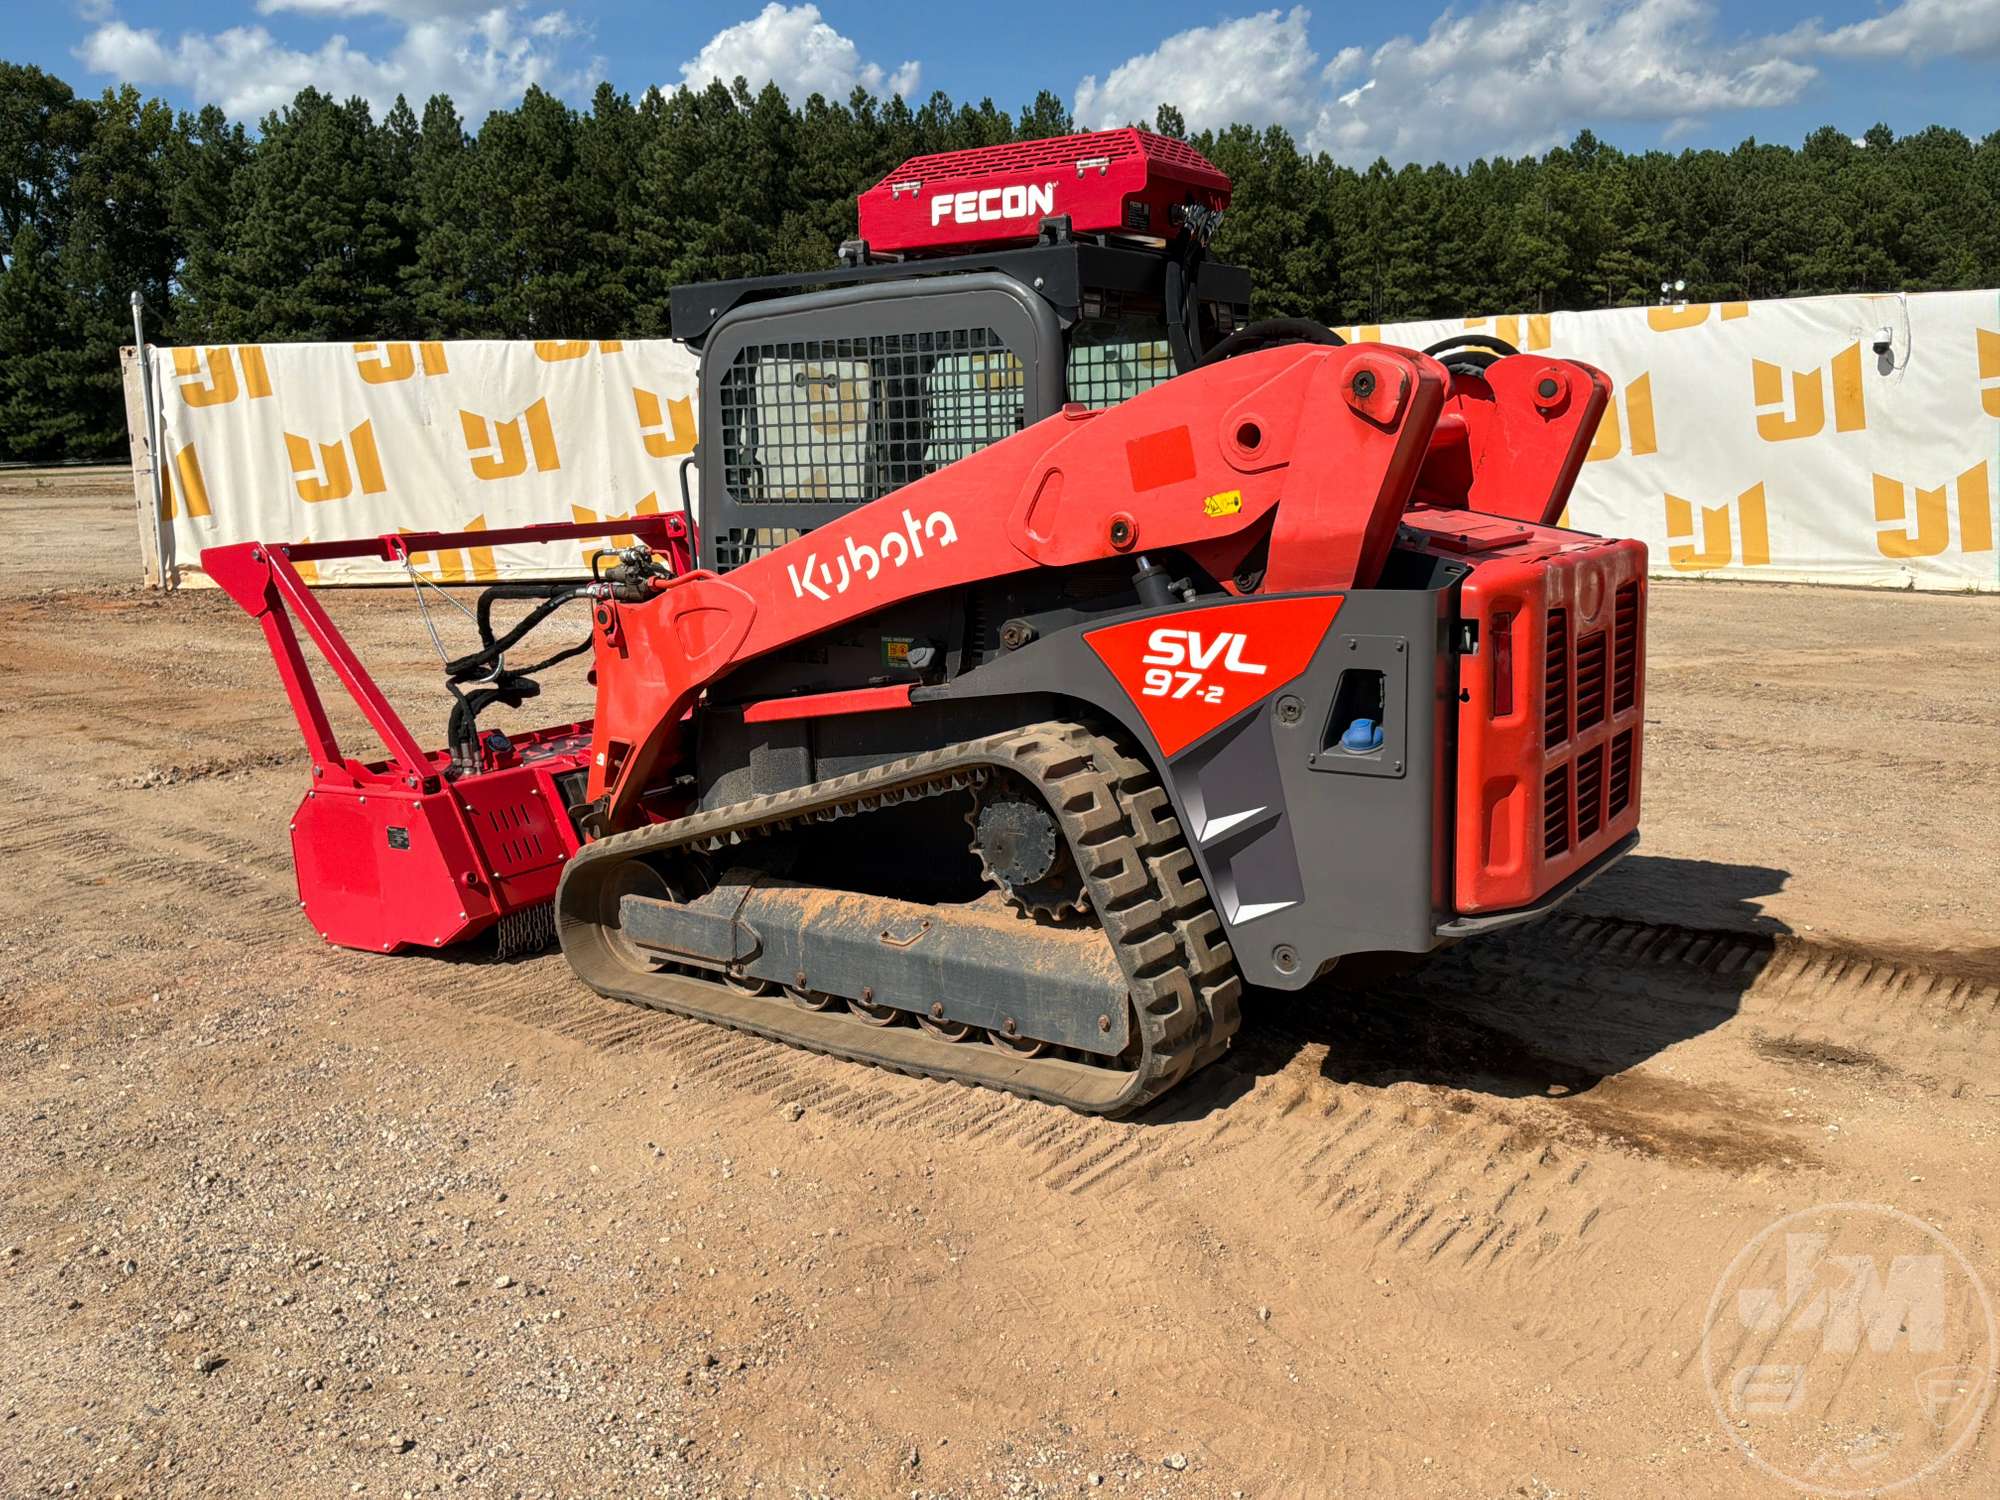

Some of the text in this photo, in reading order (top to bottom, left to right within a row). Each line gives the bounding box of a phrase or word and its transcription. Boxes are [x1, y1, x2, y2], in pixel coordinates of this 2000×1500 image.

[930, 184, 1054, 227] FECON
[786, 508, 958, 601] Kubota
[1141, 628, 1268, 675] SVL
[1141, 667, 1226, 704] 97-2
